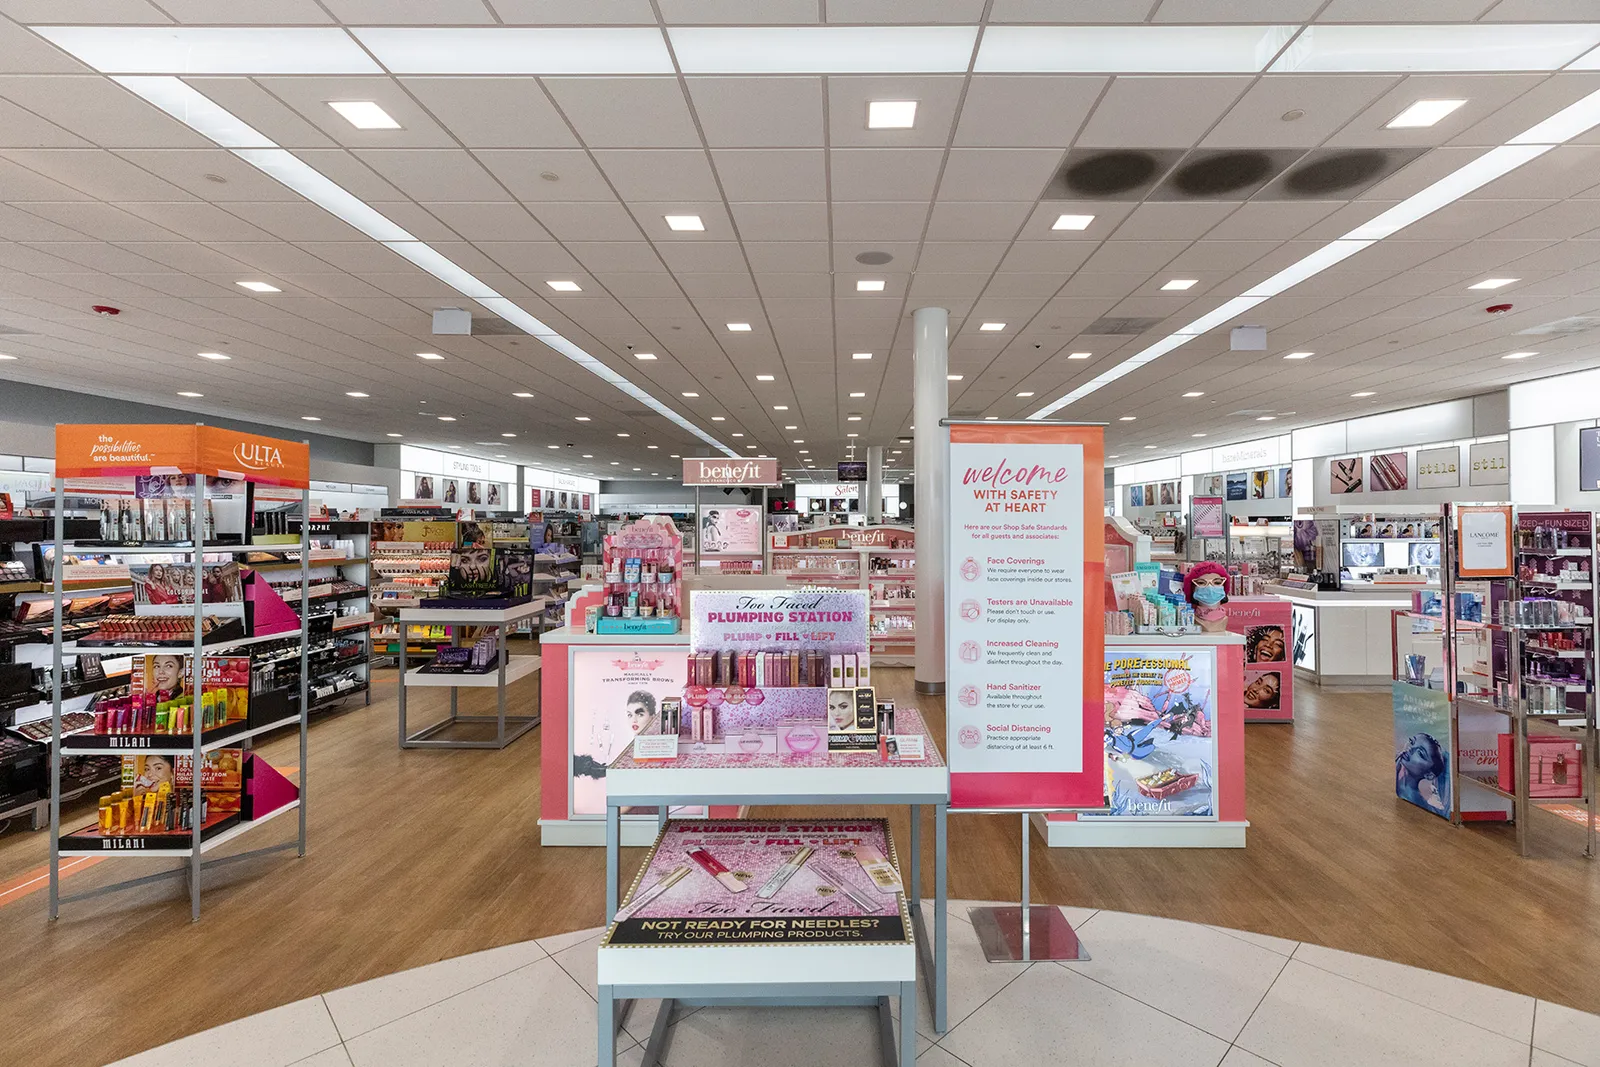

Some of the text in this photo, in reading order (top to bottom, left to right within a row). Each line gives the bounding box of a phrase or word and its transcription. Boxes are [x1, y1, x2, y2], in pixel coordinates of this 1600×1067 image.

[98, 434, 113, 442] the
[90, 440, 141, 456] possibilities
[241, 442, 283, 465] ULTA
[453, 461, 482, 474] STYLING TOOLS
[1420, 463, 1456, 475] stila
[1473, 458, 1506, 471] stil
[699, 461, 762, 482] benefit
[963, 458, 1068, 488] welcome
[974, 490, 1058, 500] WITH SAFETY
[984, 502, 1046, 512] AT HEART
[1563, 519, 1589, 527] SIZED
[842, 530, 885, 545] benefit
[1006, 557, 1045, 566] Coverings
[736, 595, 824, 610] Too Faced
[708, 611, 853, 623] PLUMPING STATION
[1228, 608, 1260, 618] benefit
[724, 632, 836, 642] PLUMP FILL LIFT
[1025, 640, 1059, 649] Cleaning
[1114, 658, 1191, 671] POREFESSIONAL
[133, 657, 144, 691] ILANI
[1011, 725, 1051, 733] Distancing
[109, 737, 151, 747] MILANI
[1127, 799, 1171, 814] benefit
[102, 839, 145, 848] MILANI
[688, 900, 835, 914] Too Faced
[642, 920, 880, 930] NOT READY FOR NEEDLES?
[657, 930, 863, 940] TRY OUR PLUMPING PRODUCTS.
